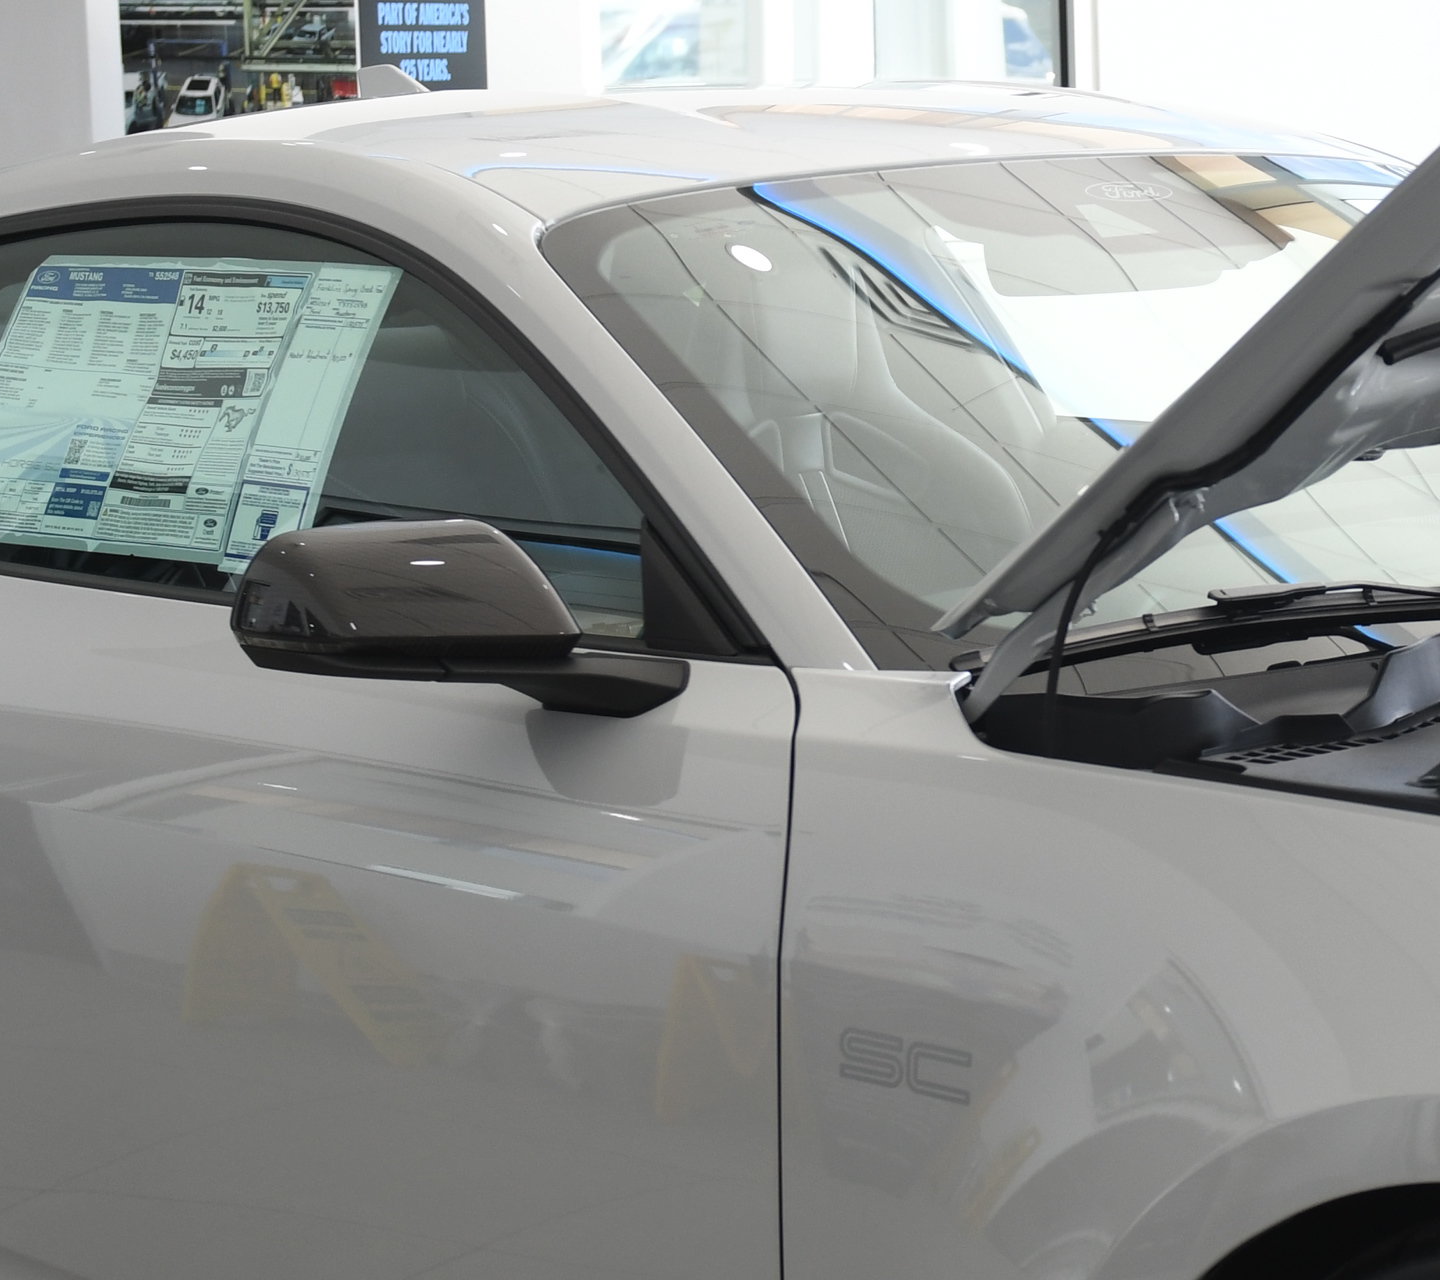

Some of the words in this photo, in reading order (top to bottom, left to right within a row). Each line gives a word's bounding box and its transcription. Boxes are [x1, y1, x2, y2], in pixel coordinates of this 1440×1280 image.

[377, 2, 404, 25] PART
[404, 2, 418, 25] OF
[419, 2, 470, 26] AMERICA'S
[380, 31, 412, 54] STORY
[413, 31, 433, 53] FOR
[433, 30, 468, 53] NEARLY
[1101, 183, 1160, 199] Ford
[68, 271, 104, 281] MUSTANG
[187, 294, 206, 315] 14
[256, 301, 291, 315] $13,750
[839, 1026, 973, 1107] SC
